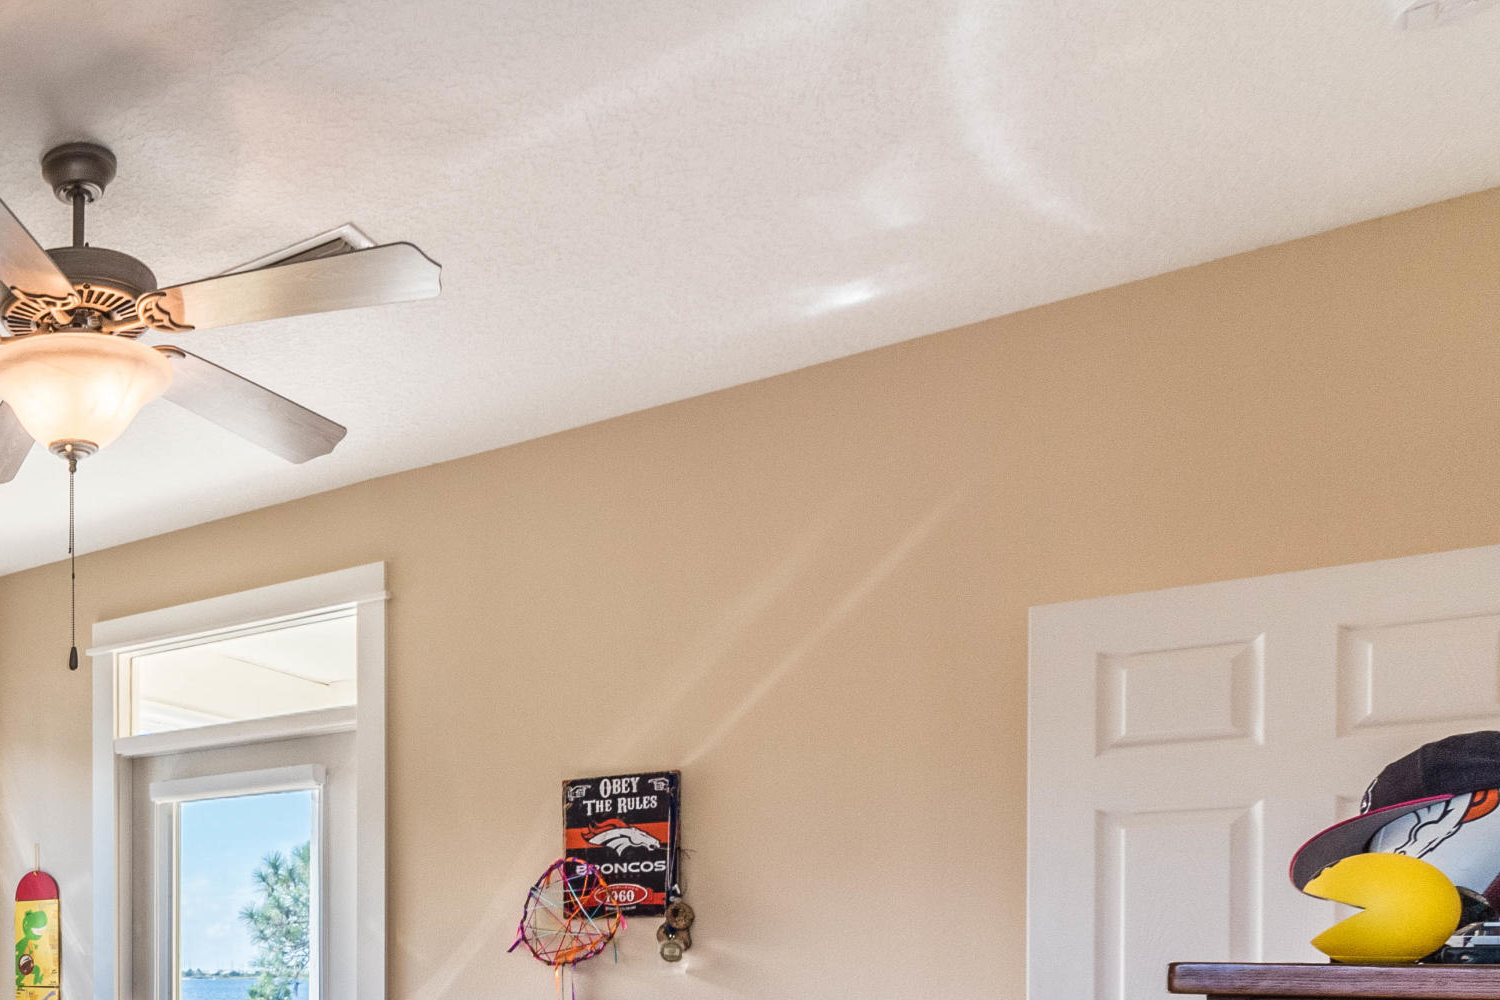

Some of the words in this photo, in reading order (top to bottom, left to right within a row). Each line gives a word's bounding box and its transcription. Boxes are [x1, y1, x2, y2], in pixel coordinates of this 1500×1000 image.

[599, 776, 640, 799] OBEY
[583, 799, 612, 816] THE
[617, 795, 658, 813] RULES
